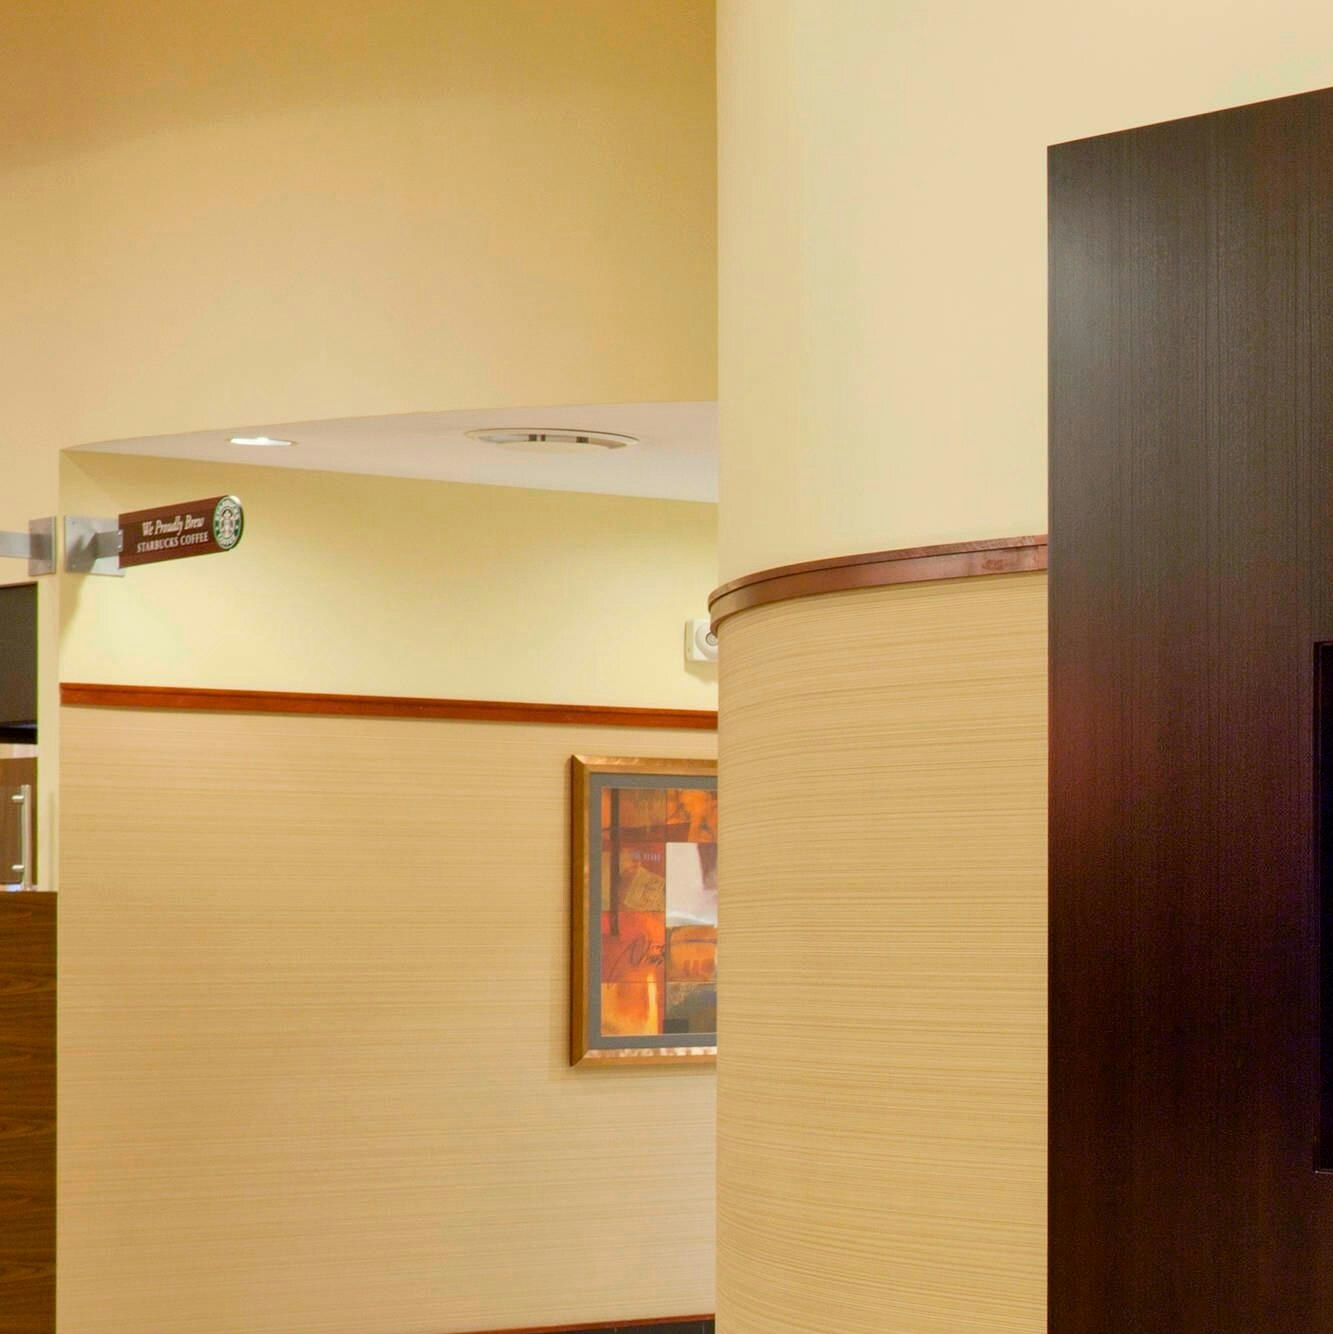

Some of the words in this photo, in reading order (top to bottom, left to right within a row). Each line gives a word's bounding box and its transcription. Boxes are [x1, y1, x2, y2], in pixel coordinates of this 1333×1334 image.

[142, 521, 154, 536] We
[154, 515, 184, 536] Proudly
[184, 514, 206, 530] Brew
[136, 536, 179, 553] STARBUCKS
[180, 531, 209, 545] COFFEE
